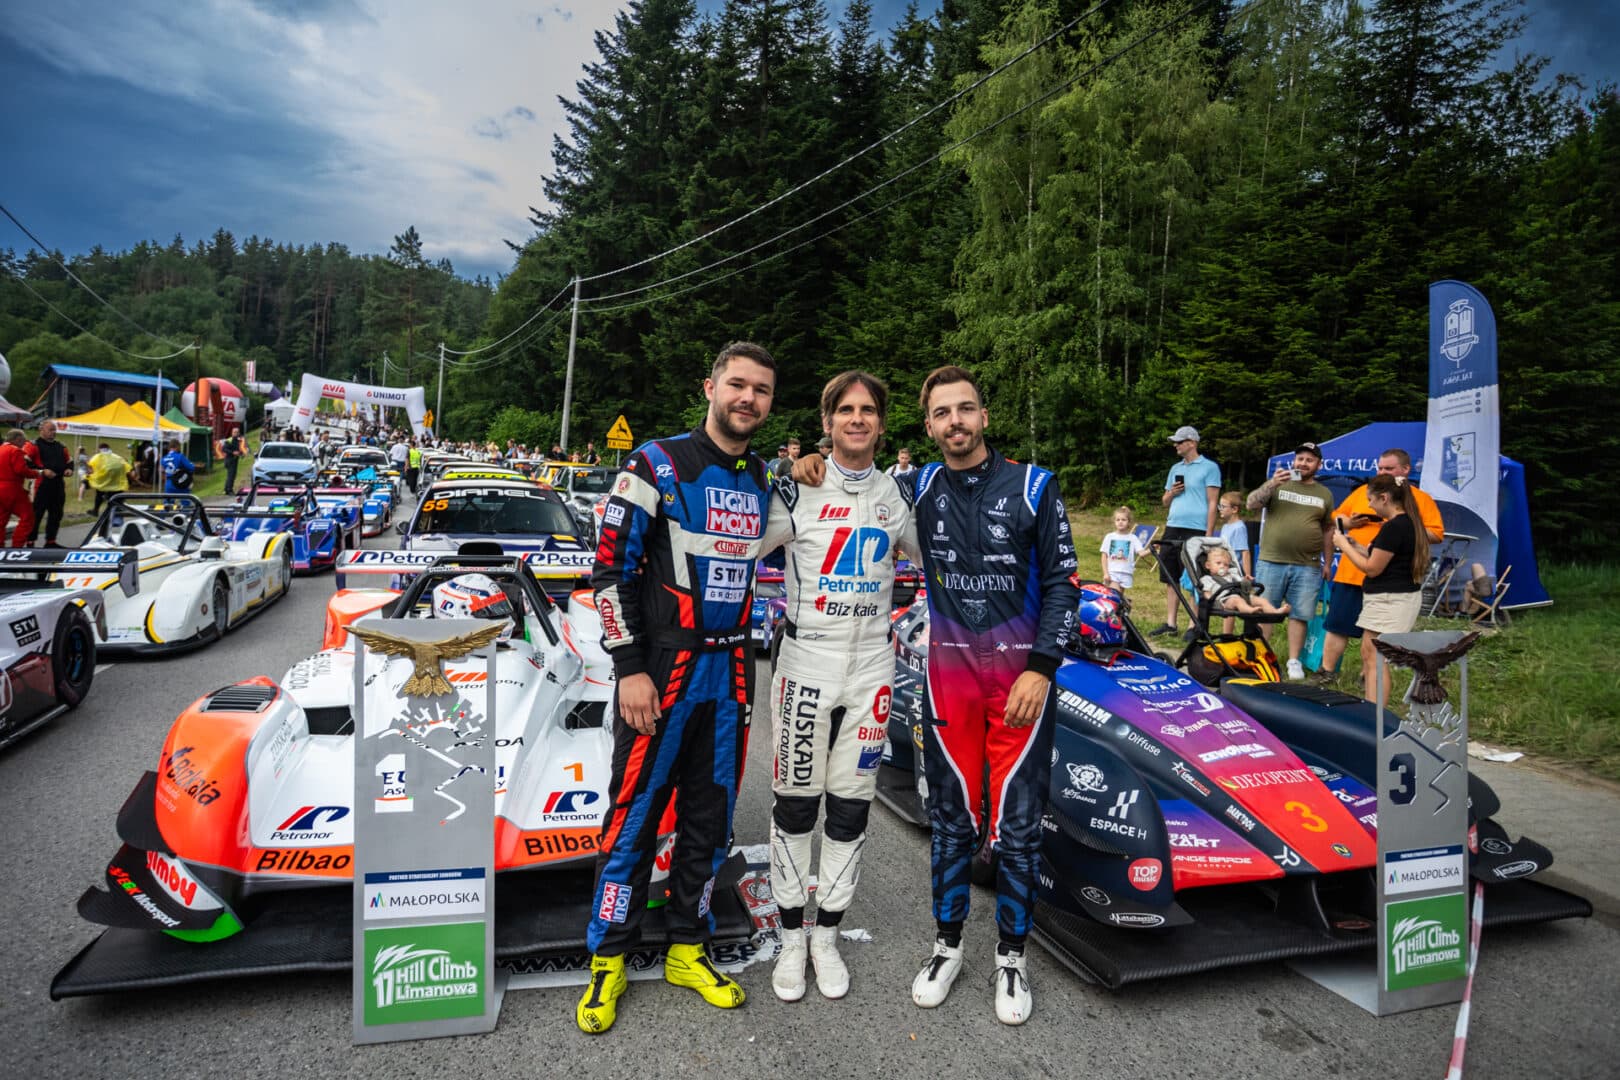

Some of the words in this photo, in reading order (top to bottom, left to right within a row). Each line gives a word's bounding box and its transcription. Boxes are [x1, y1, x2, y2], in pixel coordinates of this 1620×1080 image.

[373, 392, 407, 401] UNIMOT
[434, 488, 546, 501] DIANEL
[709, 490, 759, 514] LIQUI
[422, 499, 449, 512] 55
[709, 511, 760, 535] MOLY
[66, 552, 122, 563] LIQUI
[380, 551, 438, 565] Petro
[541, 552, 596, 566] Petro
[713, 566, 745, 583] STV
[944, 572, 1016, 592] DECOPEINT
[13, 617, 37, 635] STV
[782, 679, 797, 728] BASQUE
[792, 685, 821, 787] EUSKADI
[1128, 731, 1162, 757] Diffuse
[779, 728, 790, 786] COUNTRY
[563, 762, 584, 782] 1
[1232, 768, 1314, 790] DECOPEINT
[1388, 752, 1417, 805] 3
[543, 813, 601, 822] Petronor
[1284, 801, 1329, 833] 3
[270, 831, 334, 841] Petronor
[1090, 817, 1136, 837] ESPACE
[1137, 829, 1148, 840] H
[256, 849, 352, 872] Bilbao
[1134, 866, 1159, 877] TOP
[1401, 866, 1460, 882] MAŁOPOLSKA
[389, 891, 480, 907] MAŁOPOLSKA
[600, 884, 619, 920] MOLY
[612, 887, 630, 920] LIQUI
[133, 893, 182, 929] Motorsport
[1407, 929, 1426, 952] Hill
[1428, 925, 1460, 948] Climb
[1407, 948, 1460, 967] Limanowa
[396, 958, 425, 985] Hill
[428, 955, 478, 982] Climb
[396, 981, 478, 1000] Limanowa
